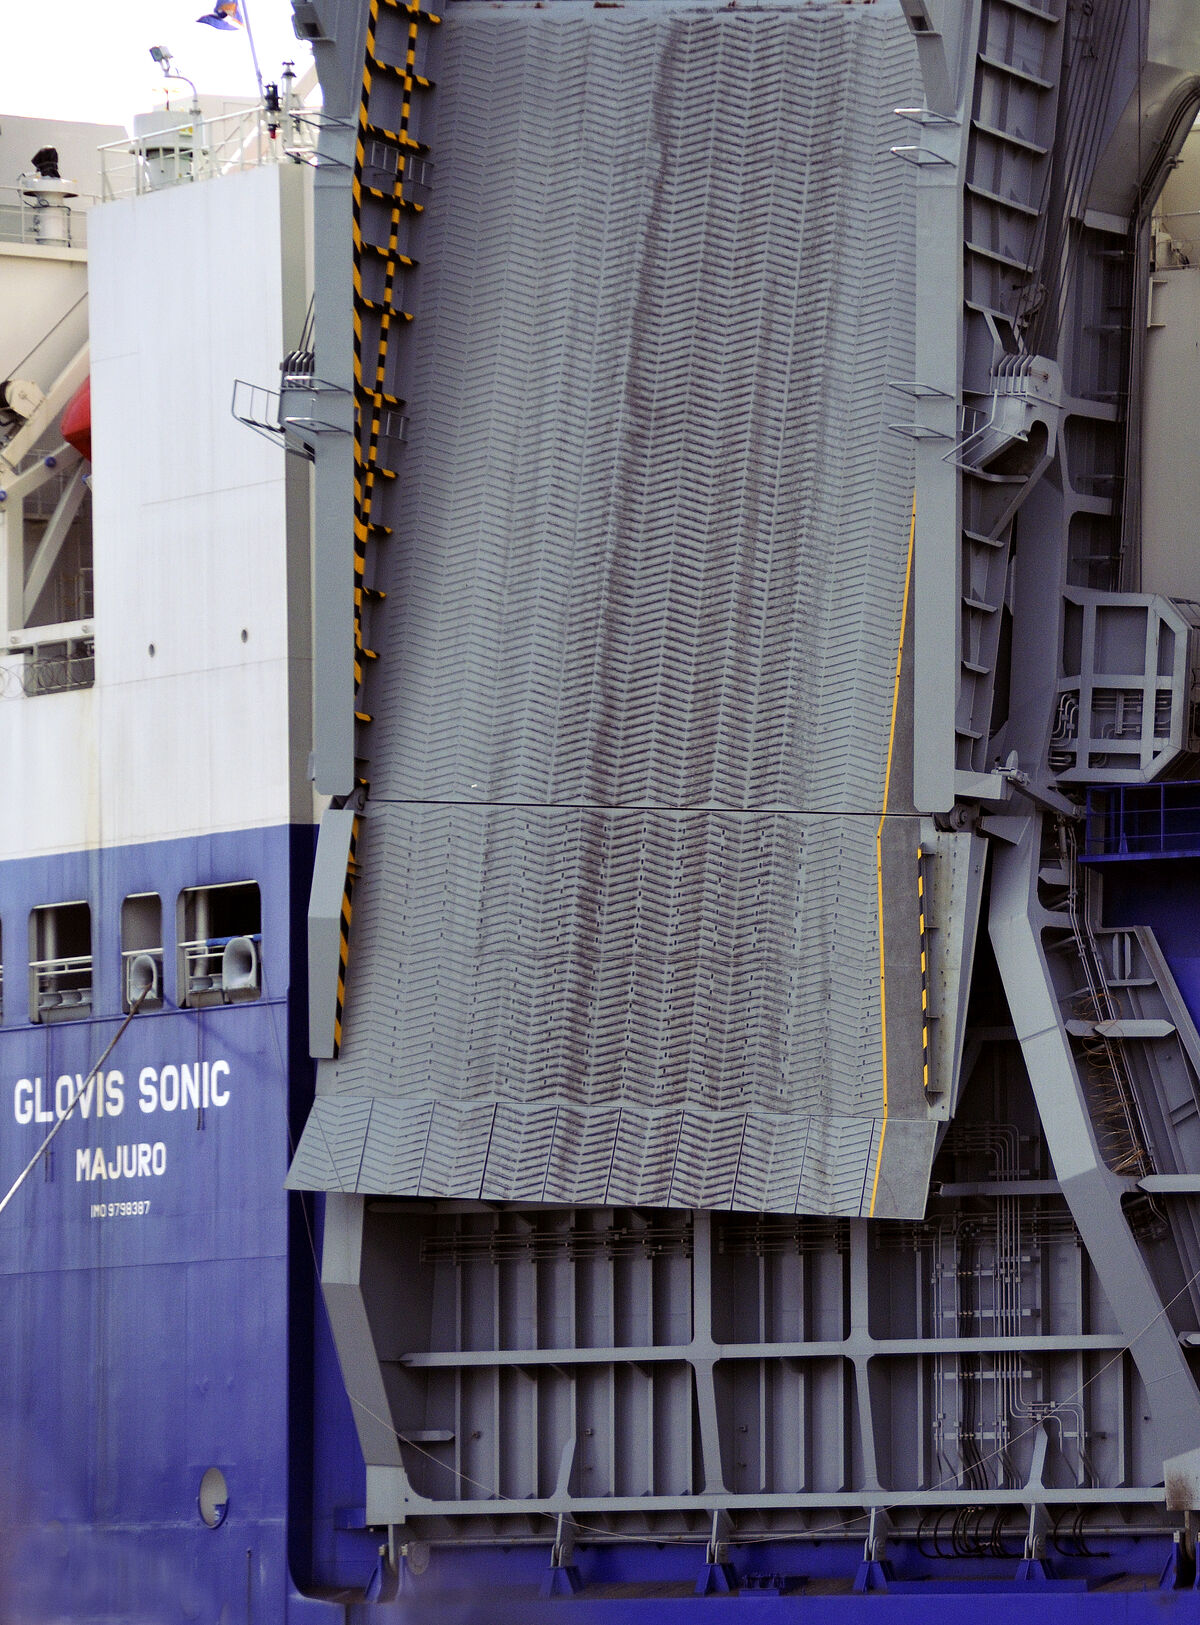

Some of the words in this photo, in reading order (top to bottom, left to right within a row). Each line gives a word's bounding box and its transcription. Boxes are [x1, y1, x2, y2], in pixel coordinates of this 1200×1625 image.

[14, 1070, 125, 1124] GLOVIS
[138, 1060, 231, 1113] SONIC
[75, 1142, 167, 1182] MAJURO
[90, 1203, 107, 1218] IMO
[107, 1200, 151, 1217] 9798387
